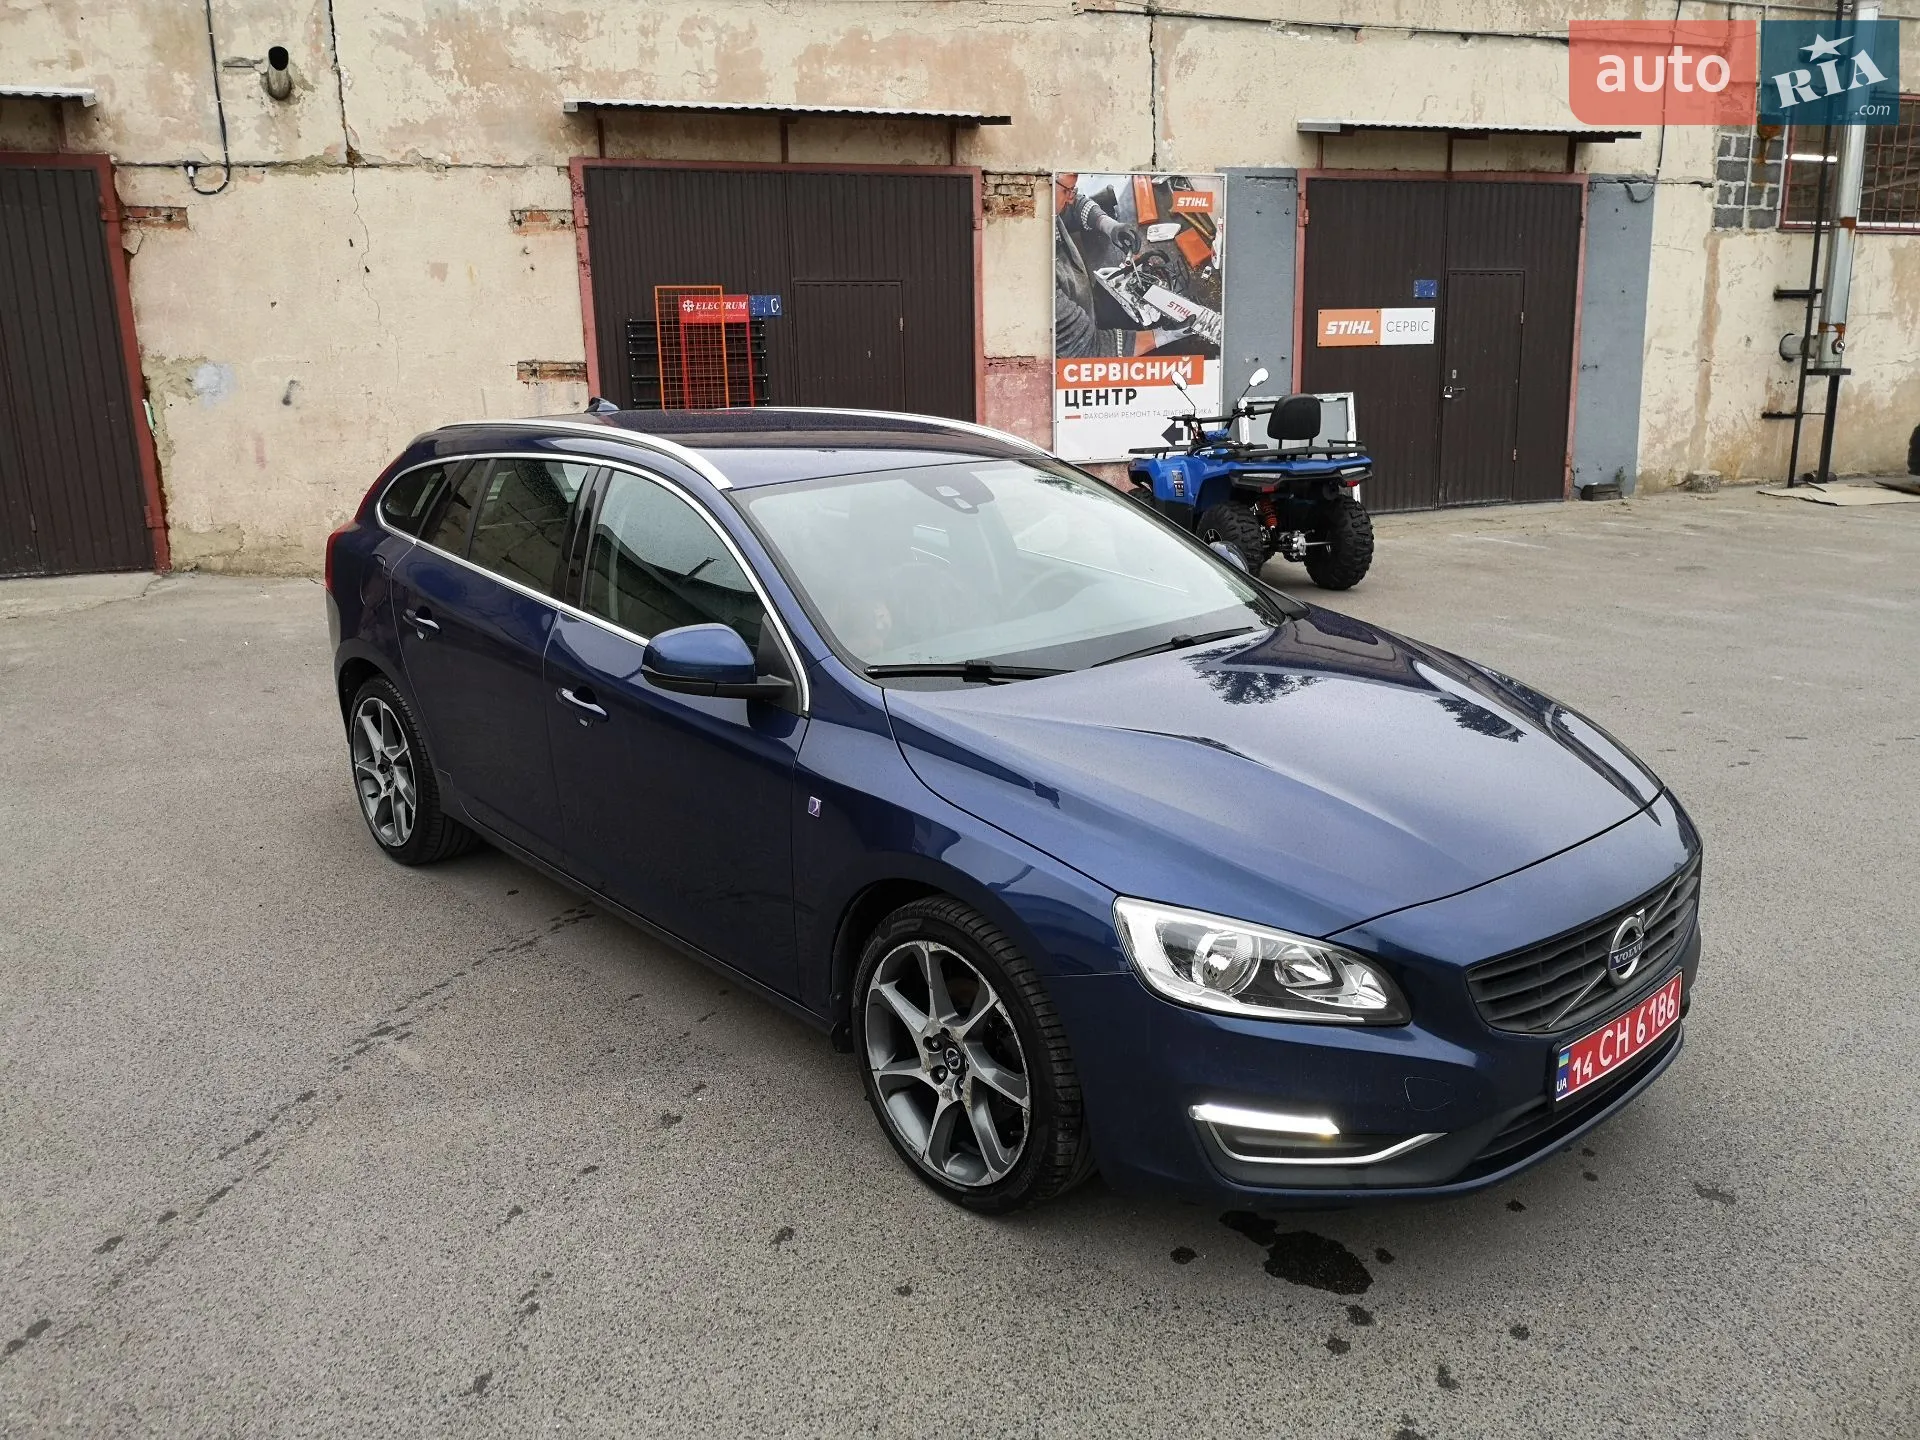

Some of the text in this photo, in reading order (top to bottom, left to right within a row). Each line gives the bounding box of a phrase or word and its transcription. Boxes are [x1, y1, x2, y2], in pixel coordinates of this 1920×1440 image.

[1176, 196, 1209, 207] STIHL
[695, 301, 747, 310] ELECTRUM
[1325, 321, 1374, 335] STIHL
[1386, 321, 1430, 333] СЕРВІС
[1063, 357, 1193, 383] СЕРВІСНИЙ
[1064, 388, 1138, 409] ЦЕНТР
[1121, 410, 1150, 418] РЕМОНТ
[1152, 409, 1161, 417] ТА
[1572, 1050, 1593, 1085] 14
[1636, 982, 1676, 1044] 6186
[1556, 1076, 1567, 1092] UA
